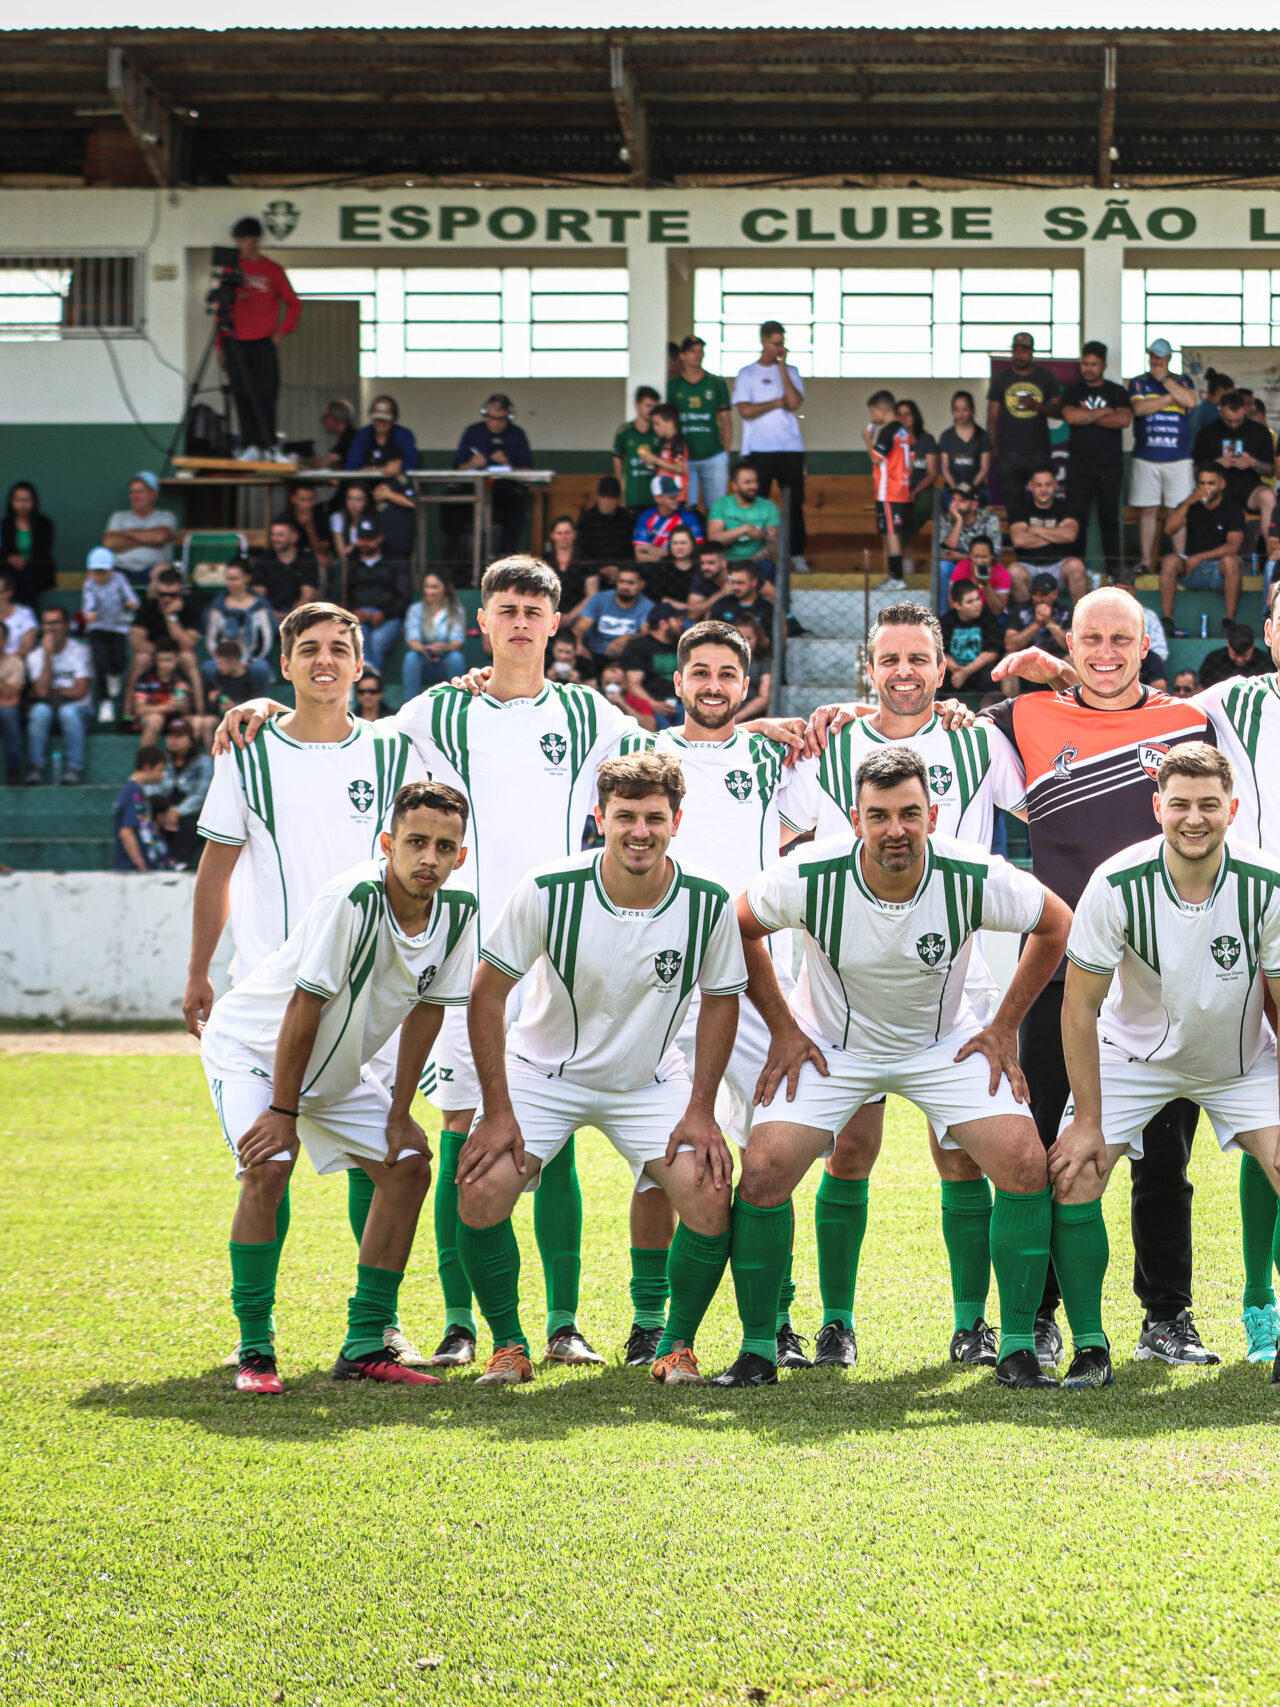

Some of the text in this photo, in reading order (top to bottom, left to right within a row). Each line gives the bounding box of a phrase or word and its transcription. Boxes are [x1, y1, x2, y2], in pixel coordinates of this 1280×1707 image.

[339, 205, 690, 243] ESPORTE
[740, 206, 993, 243] CLUBE
[1043, 199, 1197, 242] SÃO
